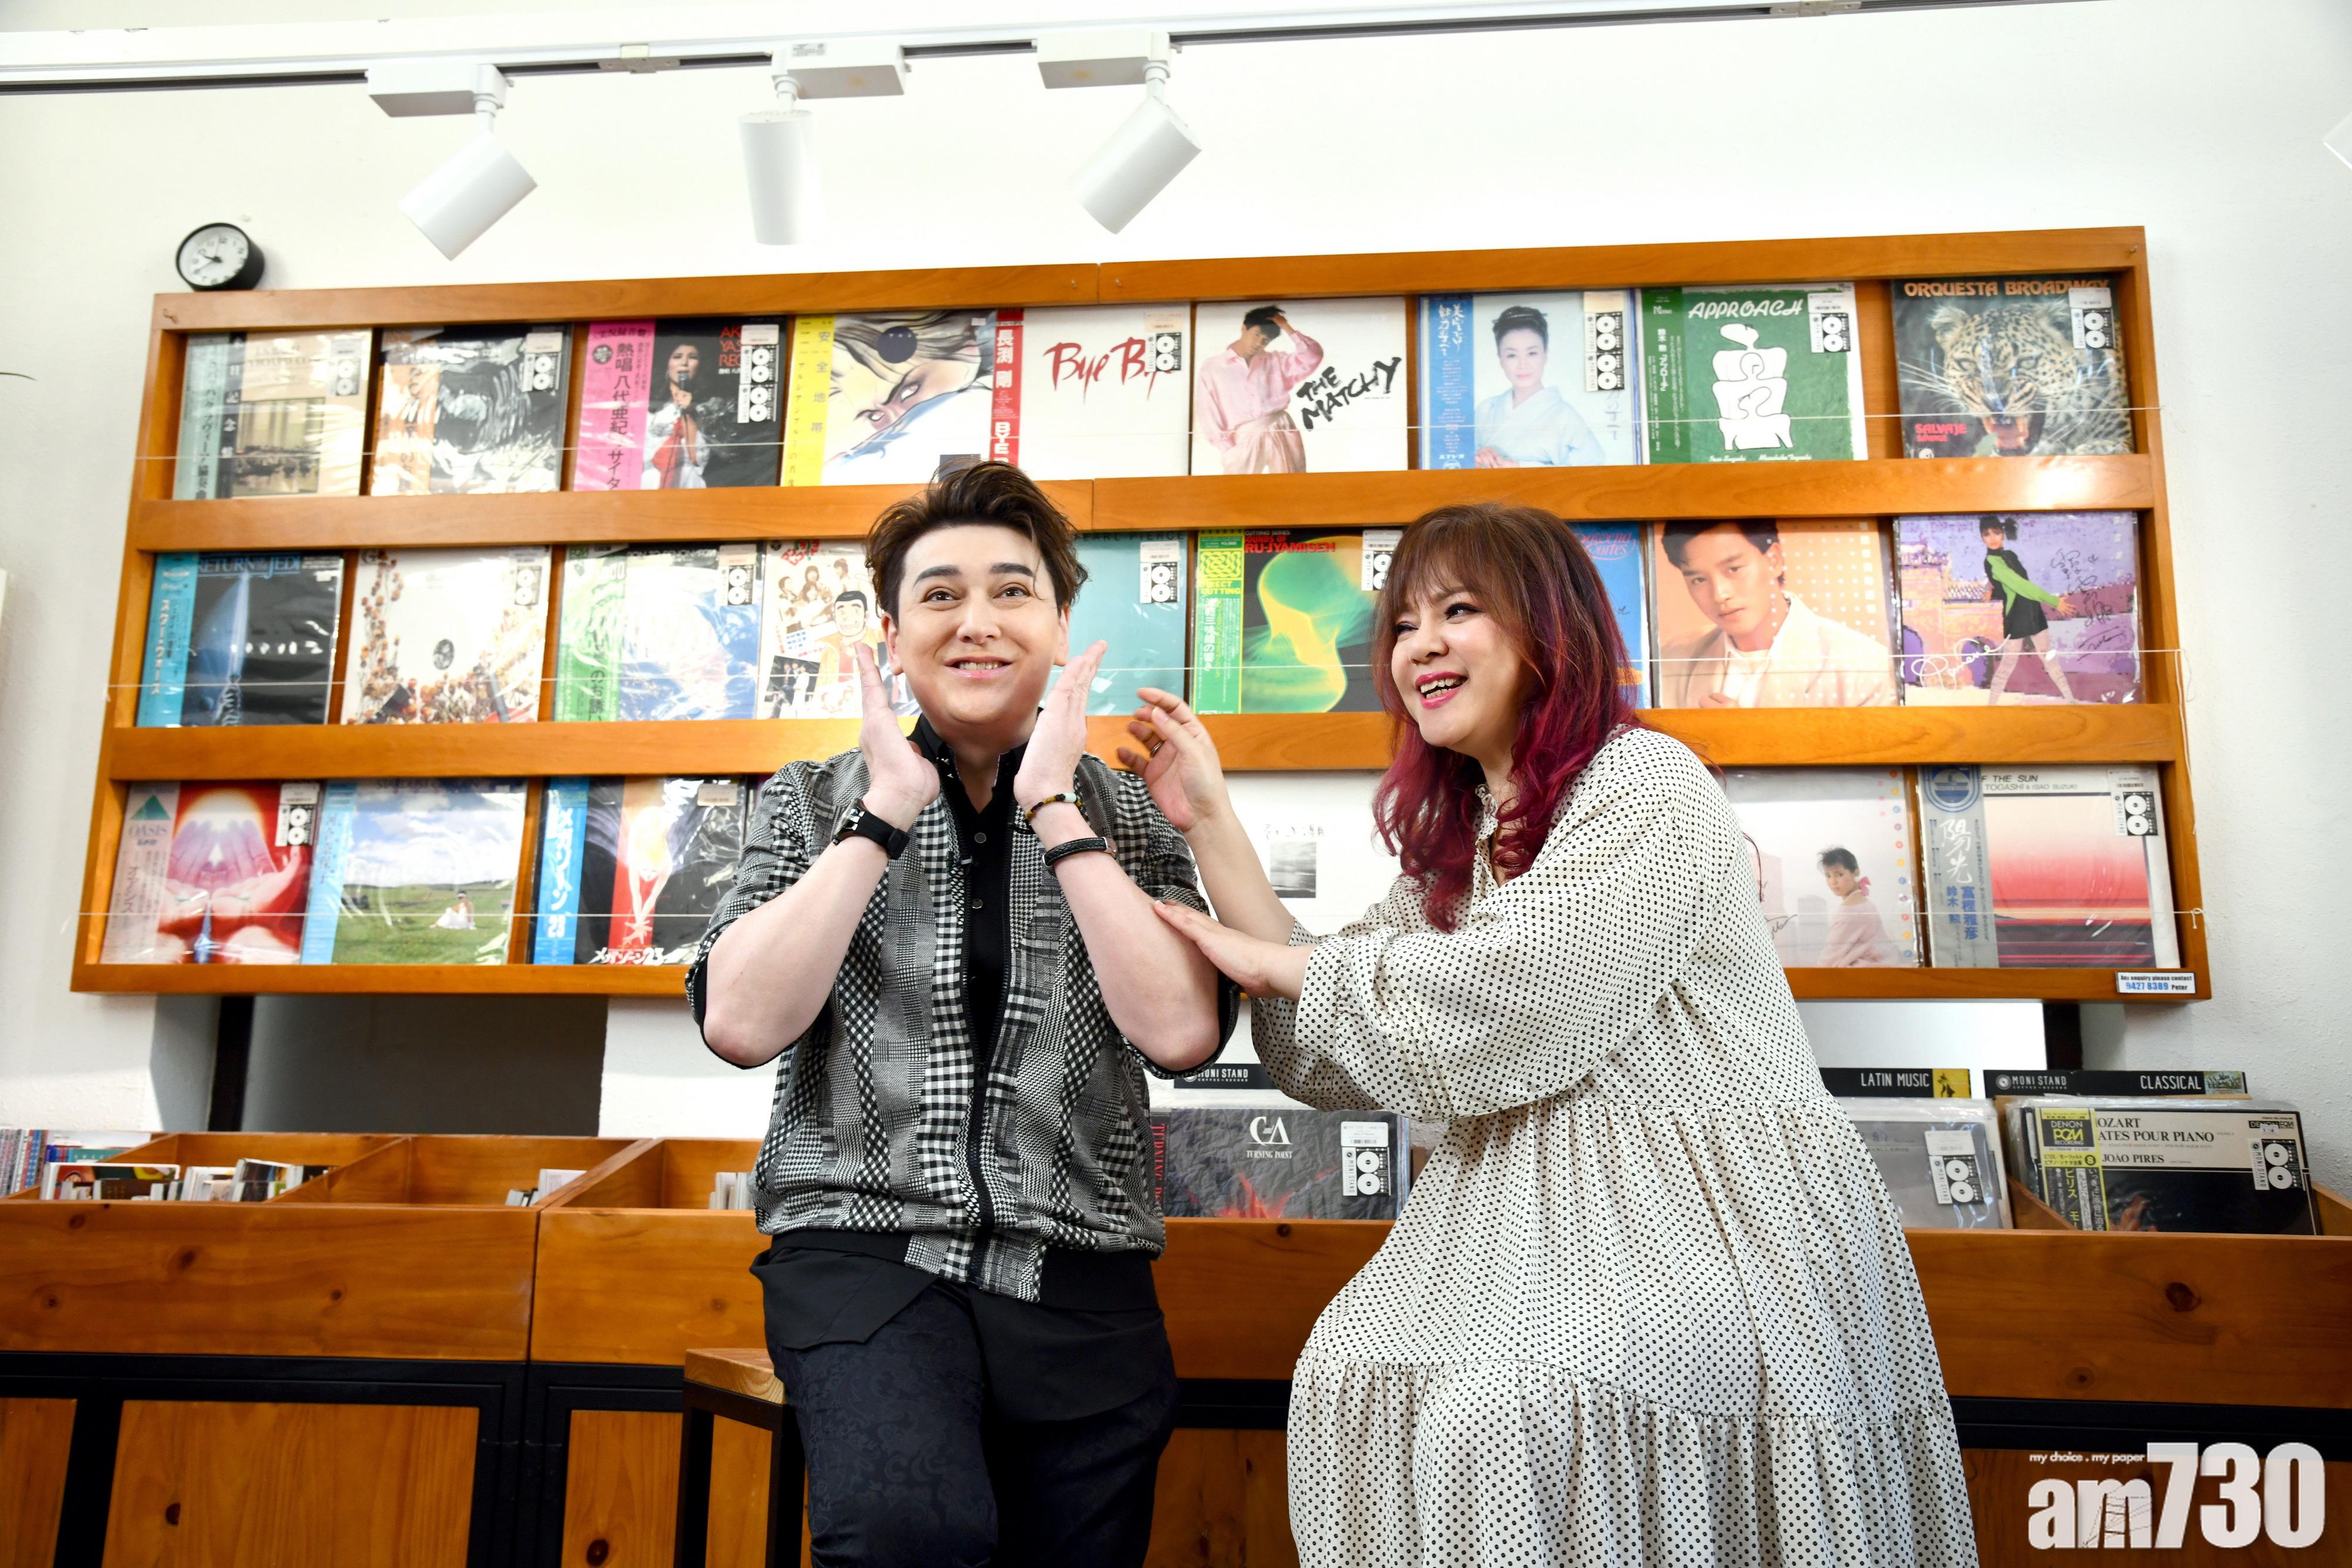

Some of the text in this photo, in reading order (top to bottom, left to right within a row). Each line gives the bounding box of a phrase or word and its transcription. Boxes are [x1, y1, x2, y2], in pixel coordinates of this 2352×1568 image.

[1905, 282, 1997, 297] ORQUESTA
[1688, 299, 1804, 320] APPROACH
[1043, 342, 1105, 404] Bye
[1297, 366, 1341, 402] THE
[1301, 356, 1402, 432] MATCHY
[1221, 1069, 1248, 1078] STAND
[1860, 1072, 1930, 1087] LATIN MUSIC
[2012, 1075, 2067, 1085] MONI STAND
[2140, 1075, 2202, 1090] CLASSICAL
[2096, 1118, 2141, 1128] OZART
[2134, 1131, 2169, 1142] POUR
[2173, 1132, 2214, 1142] PIANO
[2133, 1154, 2165, 1164] PIRES
[2257, 1168, 2267, 1187] STAND
